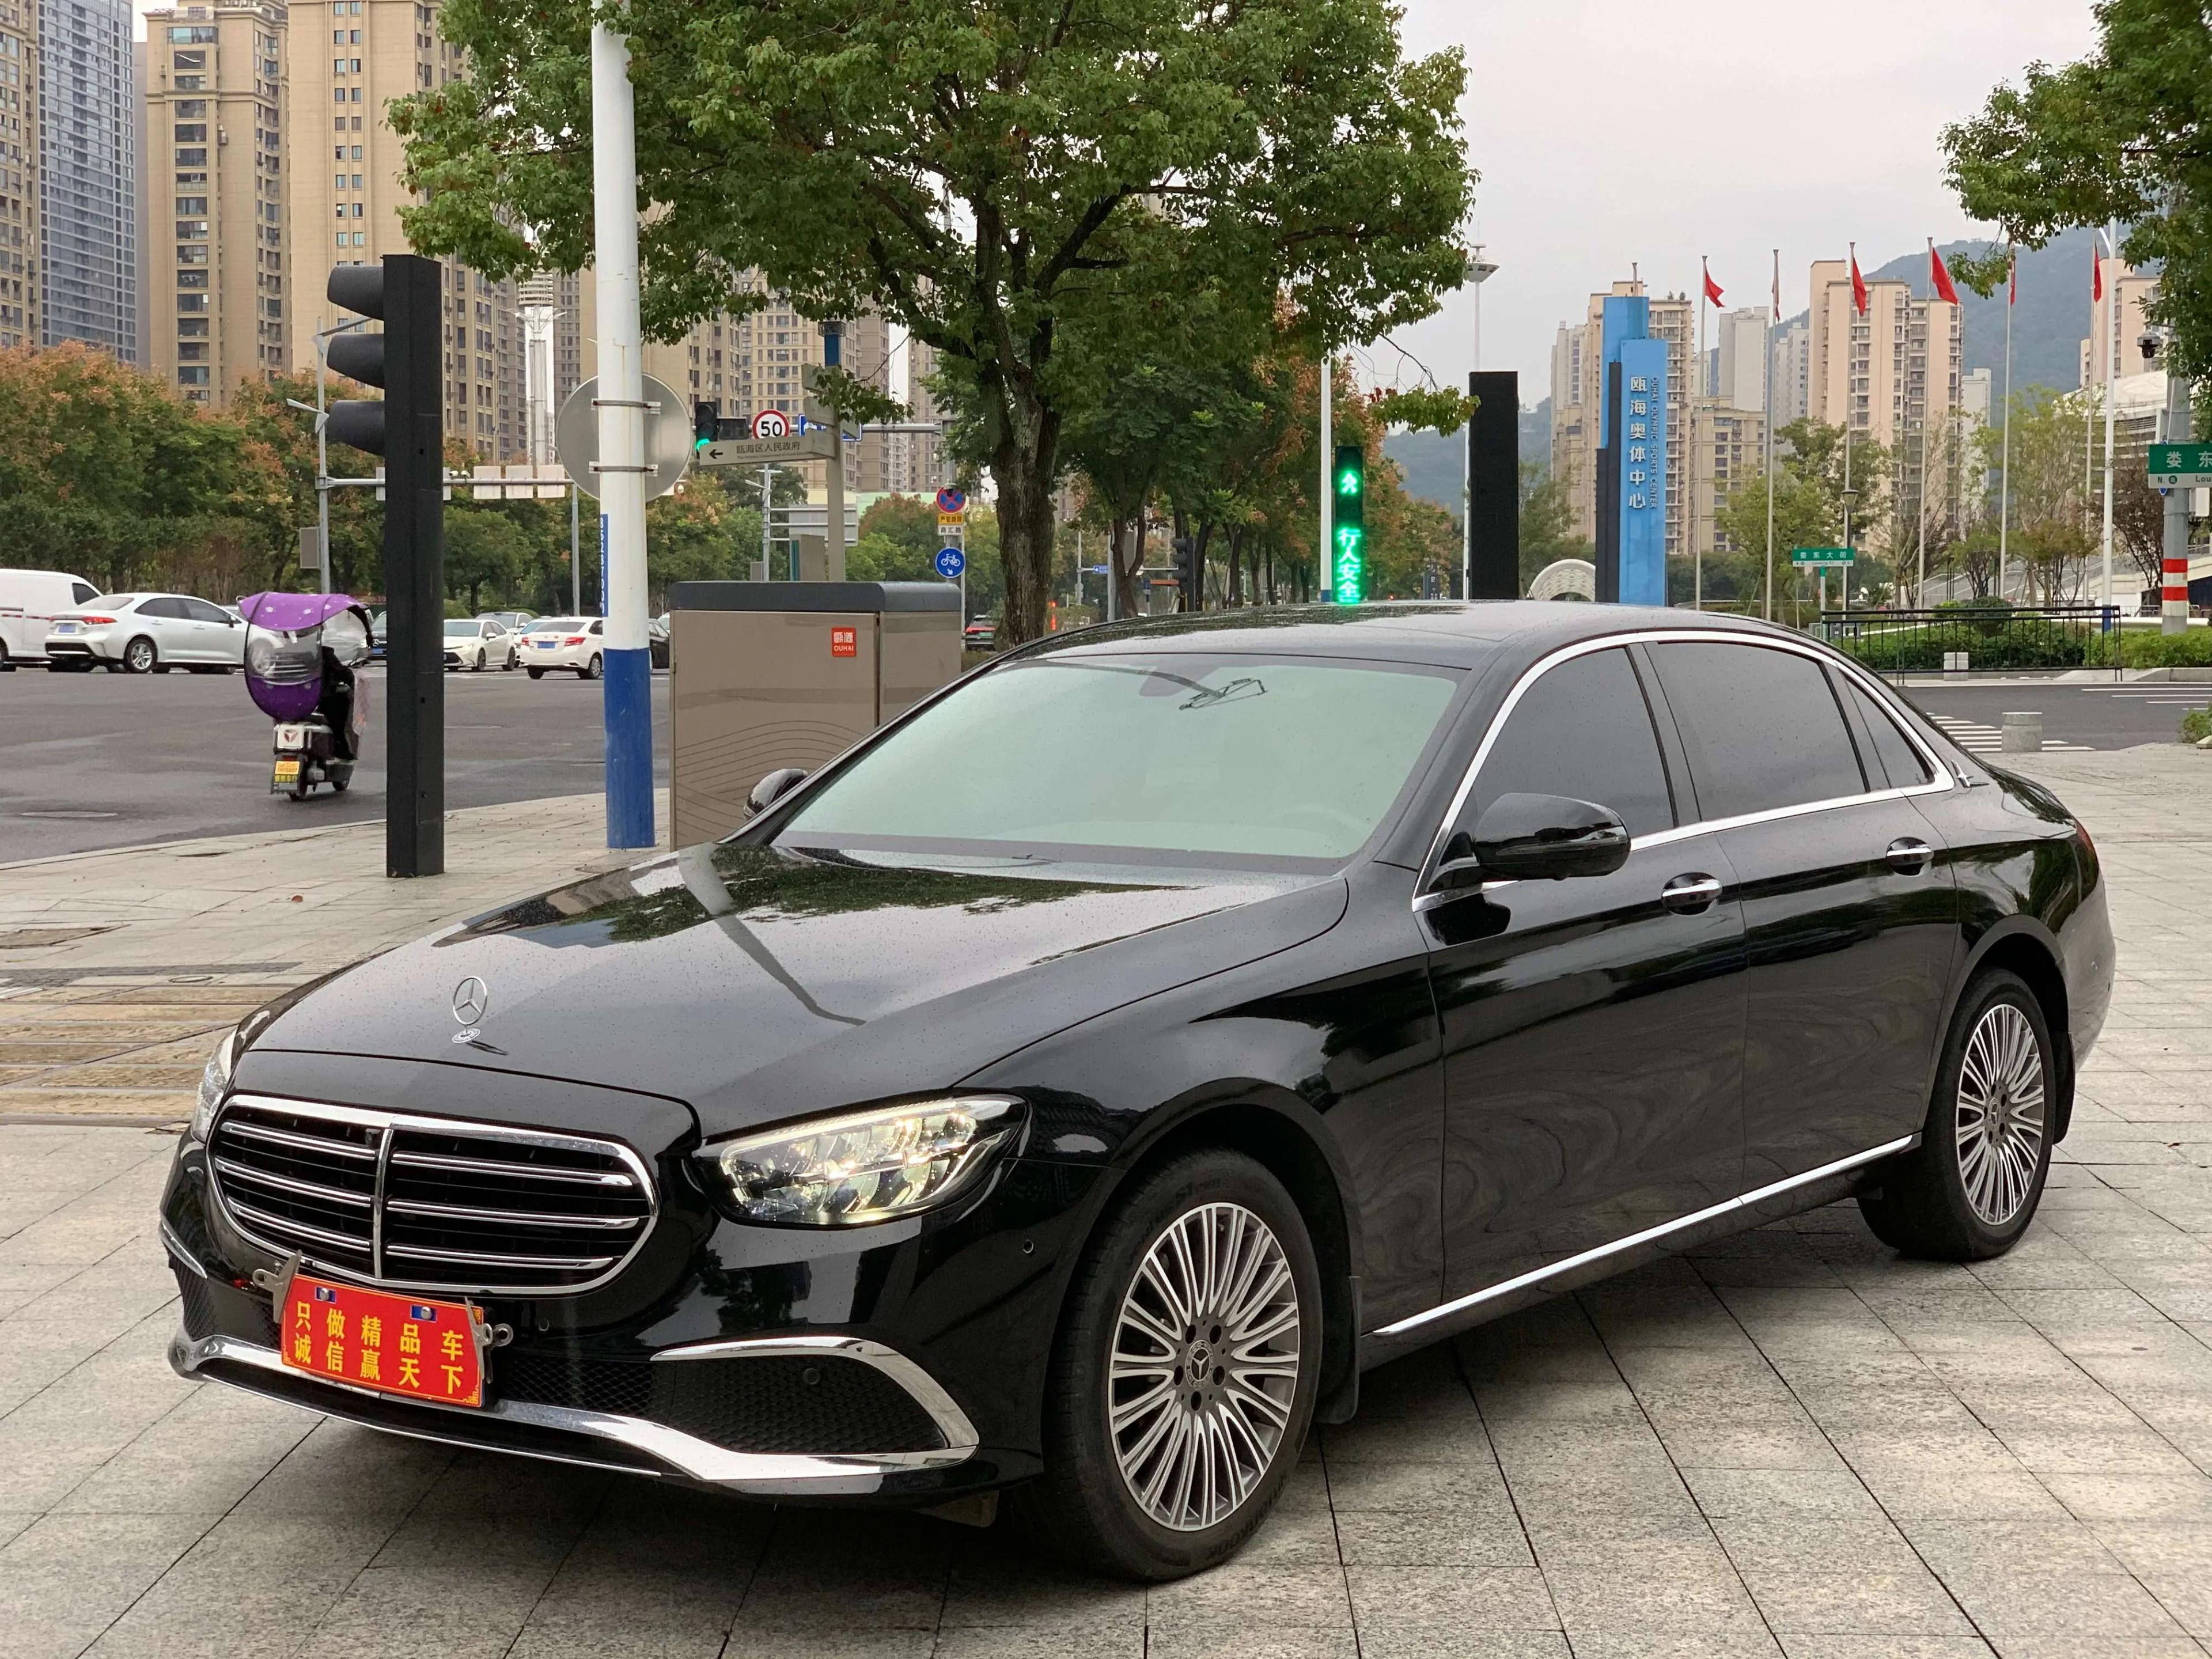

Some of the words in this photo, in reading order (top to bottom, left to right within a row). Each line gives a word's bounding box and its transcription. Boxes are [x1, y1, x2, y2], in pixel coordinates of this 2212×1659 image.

[736, 441, 801, 454] 瓯海区人民政府
[761, 421, 782, 437] 50
[1628, 377, 1647, 509] 瓯海奥体中心
[2166, 451, 2212, 468] 娄东
[1337, 528, 1361, 604] 行人安全
[295, 1301, 464, 1361] 只做精品车
[294, 1332, 464, 1395] 诚信赢天下
